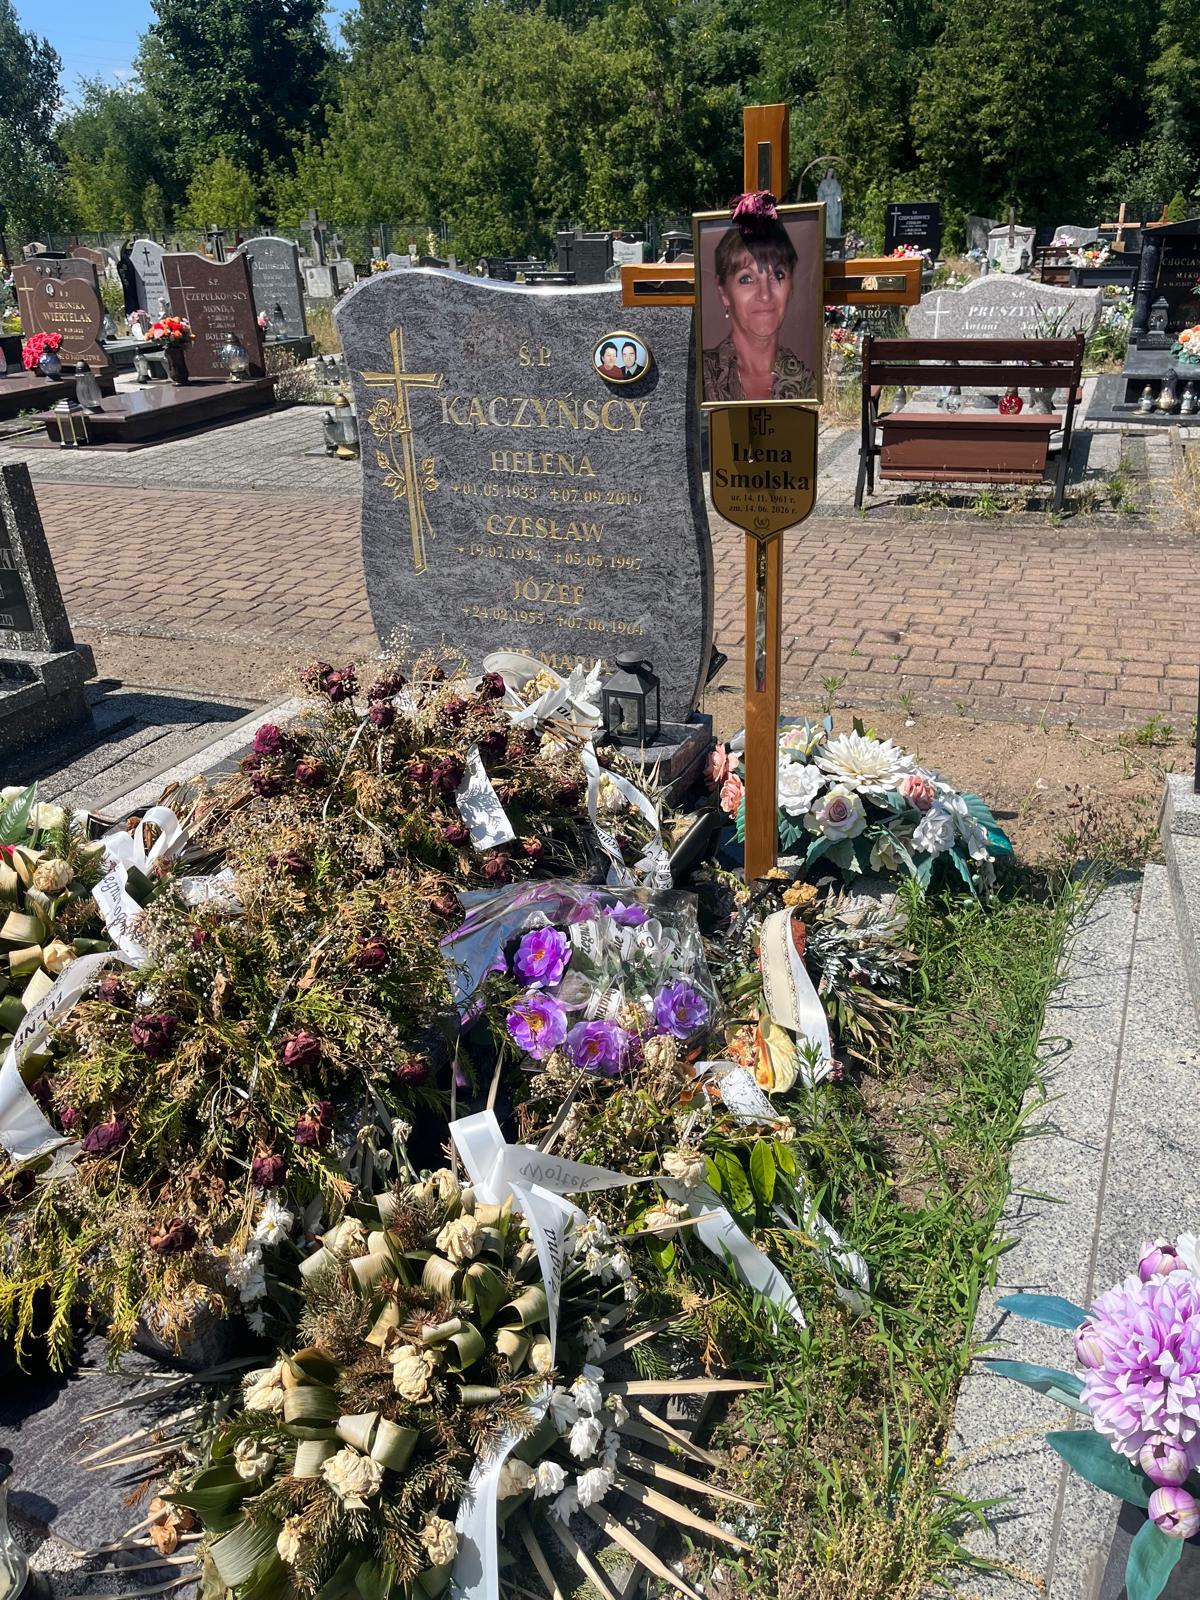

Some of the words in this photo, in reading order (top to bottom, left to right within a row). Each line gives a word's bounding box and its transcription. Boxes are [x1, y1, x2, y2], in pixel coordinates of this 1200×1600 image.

[41, 311, 93, 323] WIERTELAK
[962, 321, 999, 331] Antoni
[438, 392, 649, 431] KACZYŃSCY
[489, 450, 599, 477] HELENA
[715, 468, 810, 491] Smolska
[485, 514, 605, 543] CZESŁAW
[512, 576, 585, 606] JÓZEF
